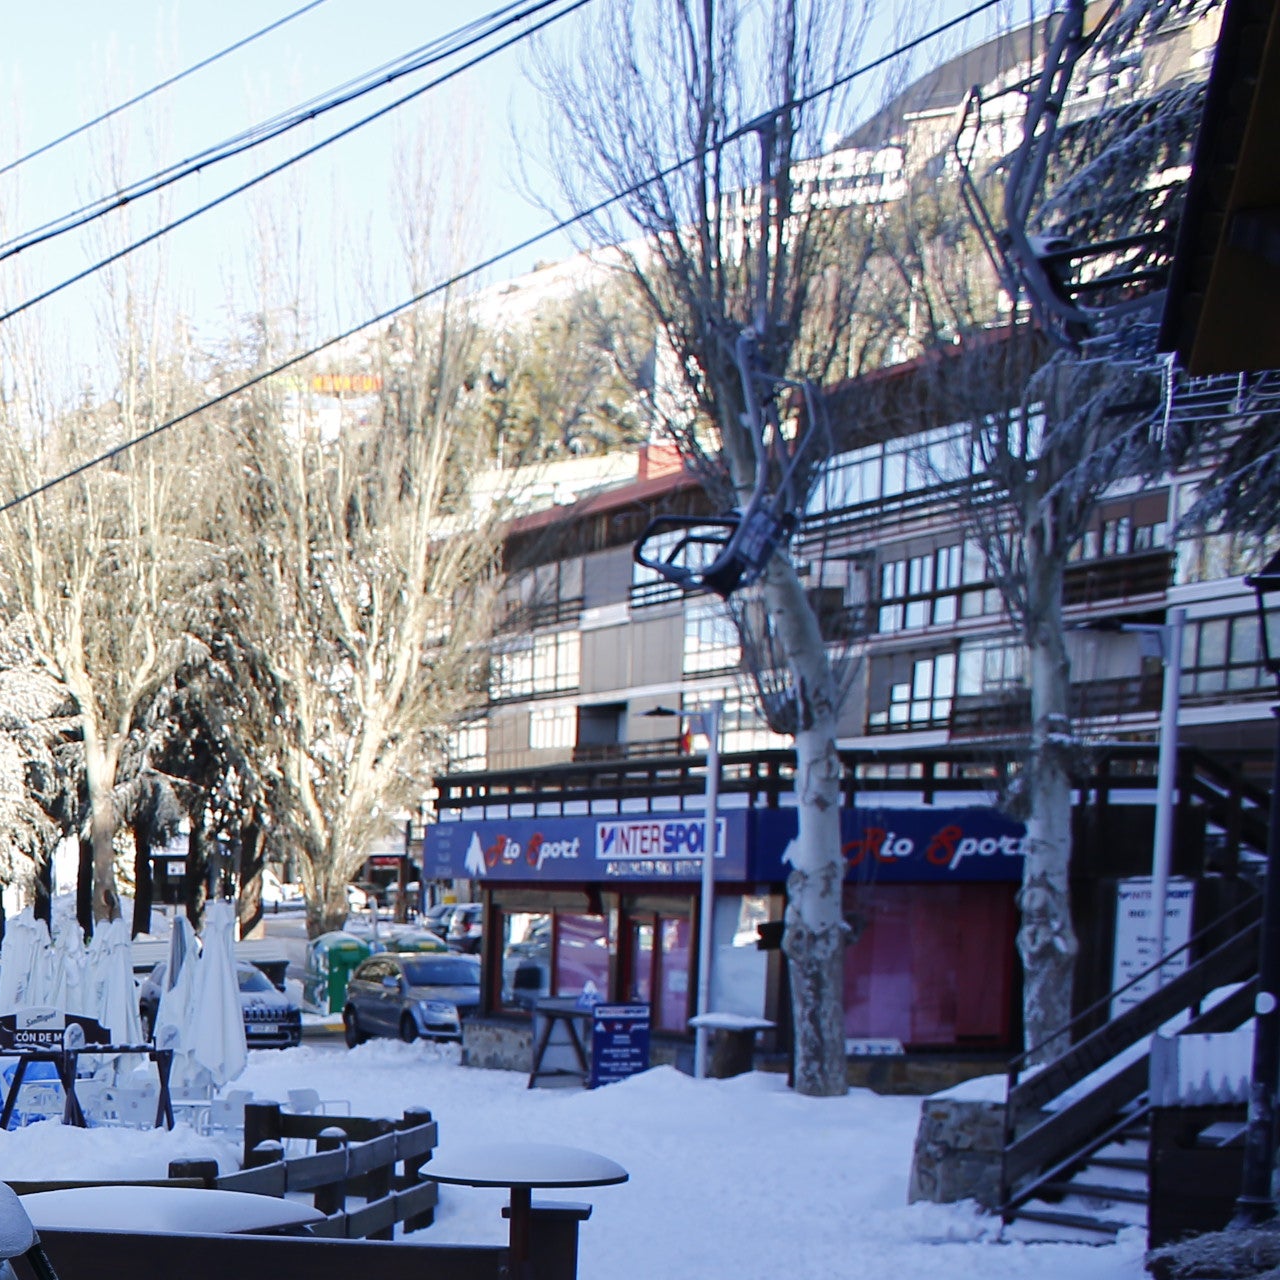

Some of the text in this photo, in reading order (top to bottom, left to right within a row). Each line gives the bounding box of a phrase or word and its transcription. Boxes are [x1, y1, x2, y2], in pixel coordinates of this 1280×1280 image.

[526, 832, 580, 871] Sport
[842, 827, 914, 867] Rio
[16, 1030, 37, 1042] CÓN
[39, 1033, 52, 1042] DE
